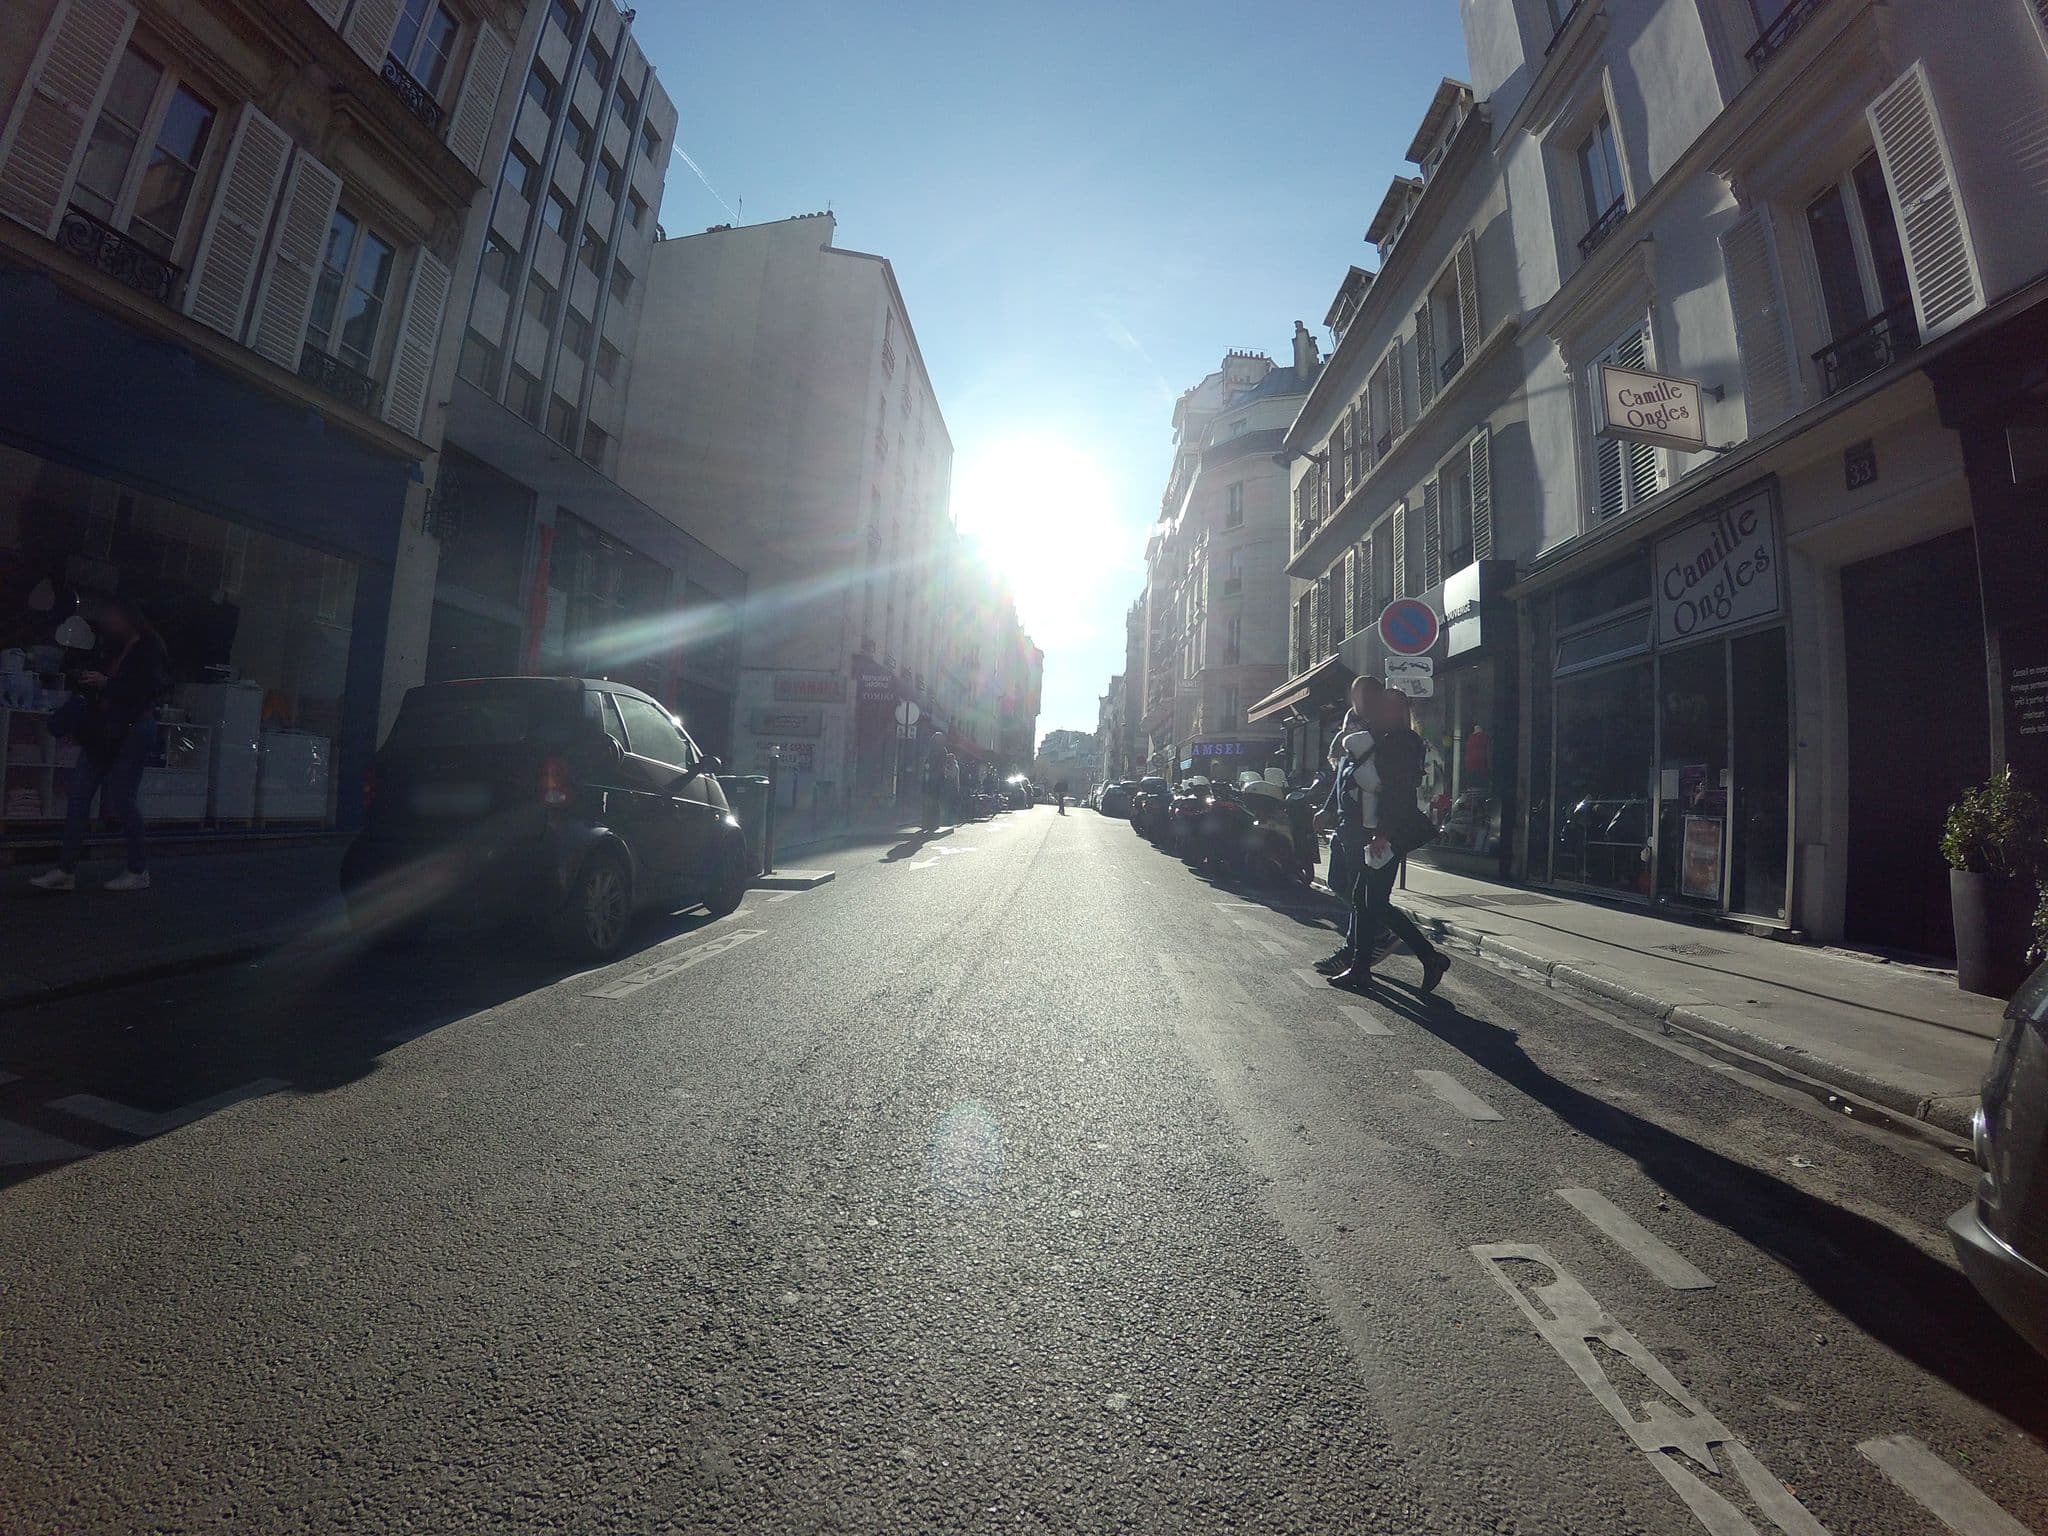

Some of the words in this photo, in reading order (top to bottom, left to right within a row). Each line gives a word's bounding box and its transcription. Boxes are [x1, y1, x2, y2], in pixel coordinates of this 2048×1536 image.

[1618, 382, 1683, 408] Camille
[1626, 403, 1690, 430] Ongles
[1662, 508, 1758, 601] Camille
[1673, 545, 1770, 635] Ongles
[1192, 742, 1243, 756] AMSEL
